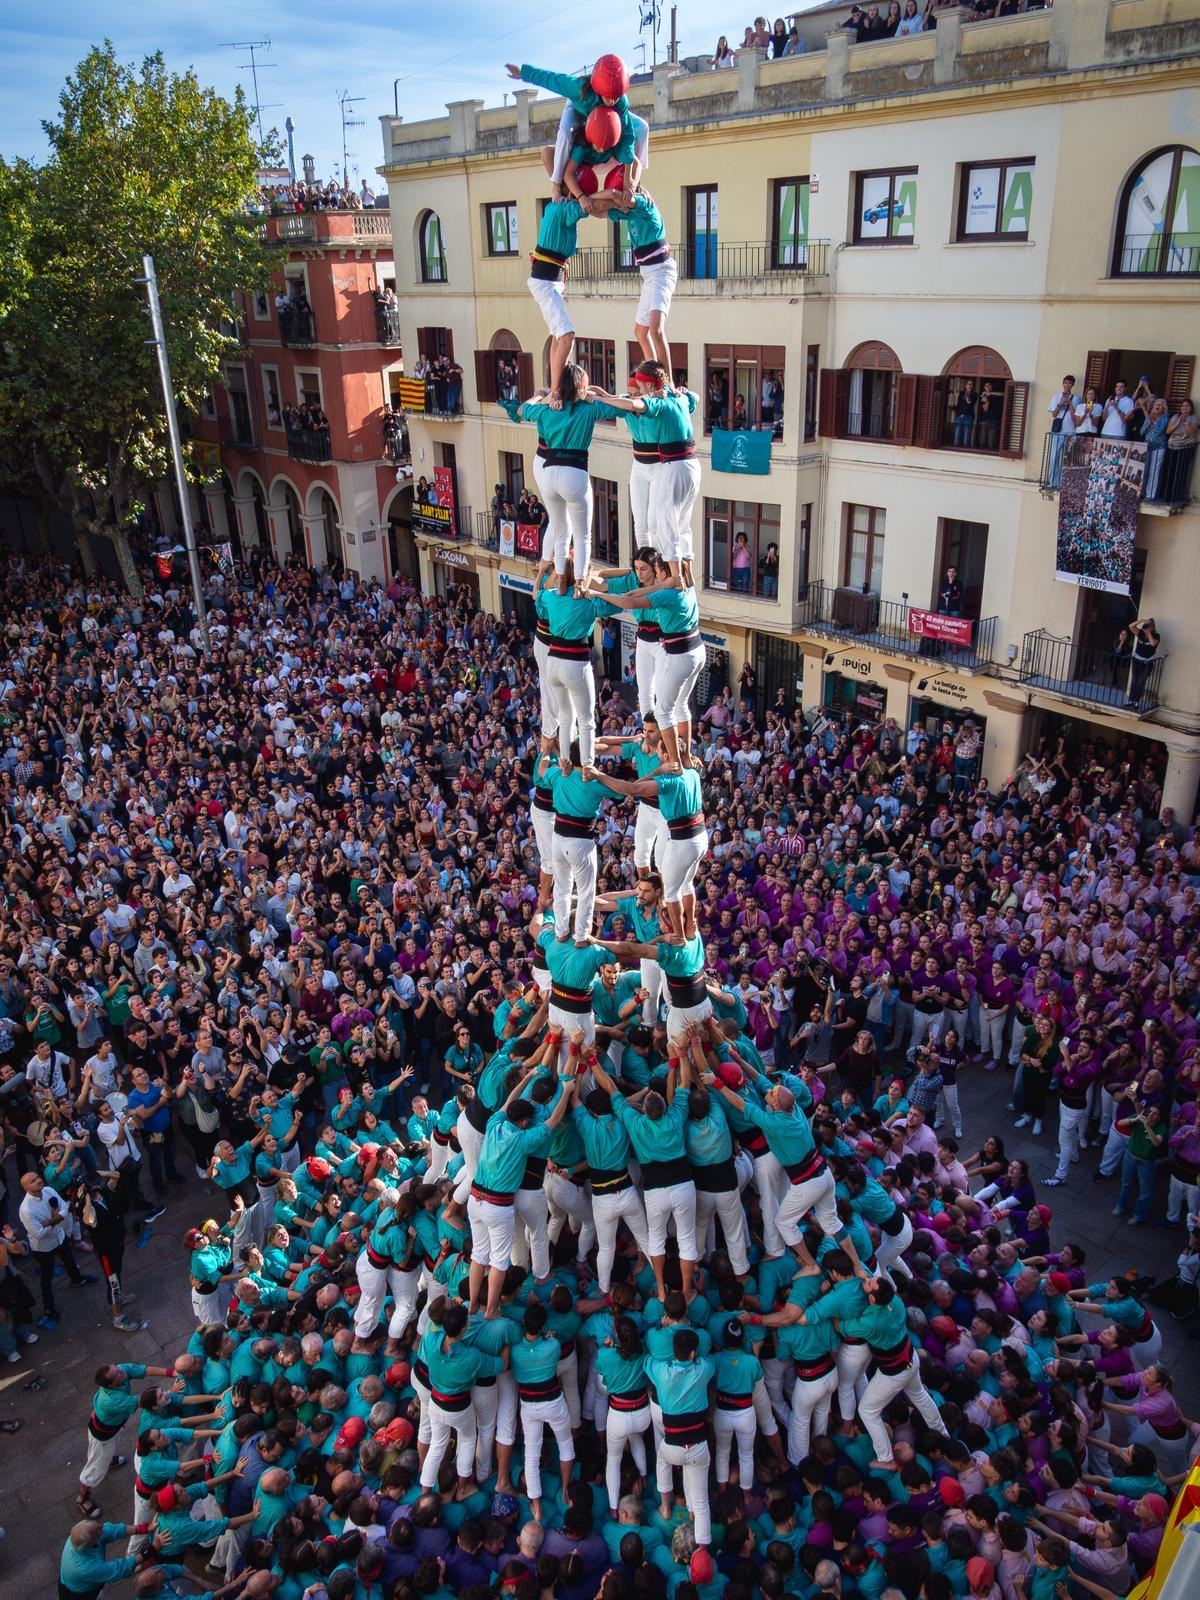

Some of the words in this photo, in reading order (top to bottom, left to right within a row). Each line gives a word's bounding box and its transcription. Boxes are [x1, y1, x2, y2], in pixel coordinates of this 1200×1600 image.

[1001, 171, 1033, 233] A
[492, 211, 509, 252] A
[1076, 575, 1108, 591] XERIGOTS
[941, 681, 957, 691] botiga
[937, 687, 951, 695] festa
[951, 692, 968, 702] major
